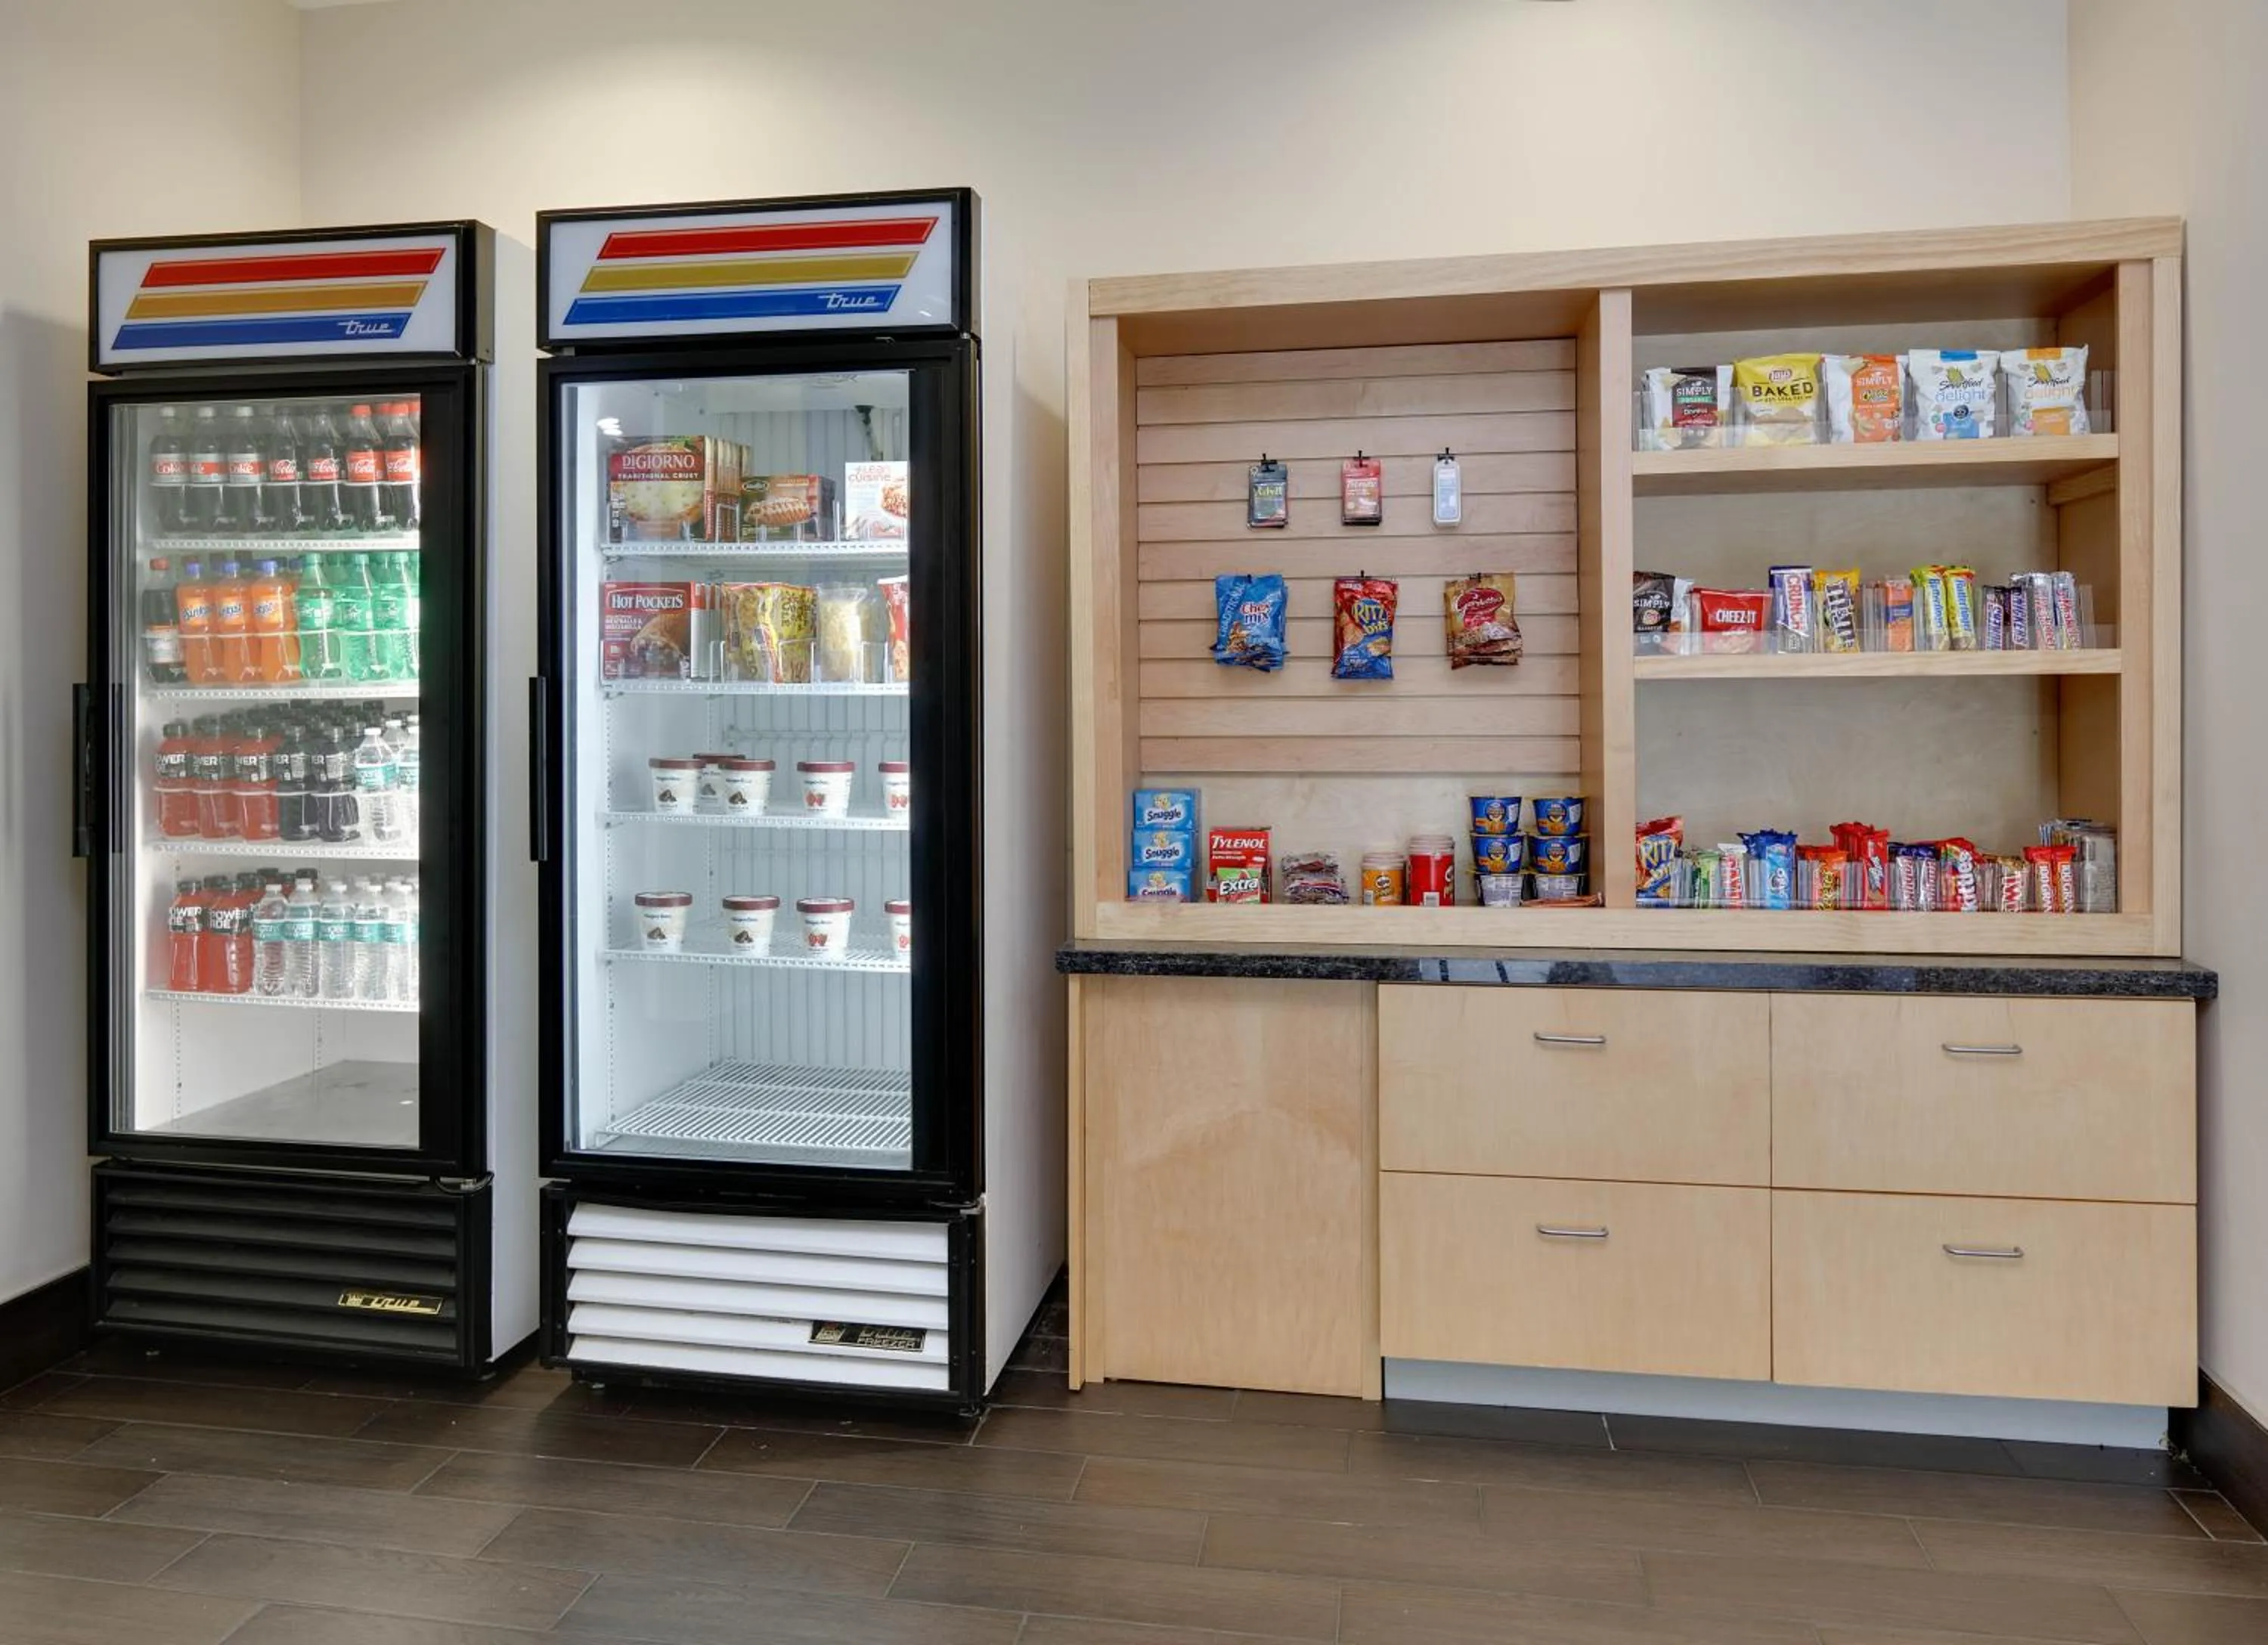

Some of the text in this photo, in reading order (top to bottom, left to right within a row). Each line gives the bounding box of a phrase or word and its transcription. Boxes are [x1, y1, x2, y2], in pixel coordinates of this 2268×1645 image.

[818, 293, 882, 309] true
[337, 320, 395, 336] true
[1676, 386, 1714, 397] SIMPLY
[1752, 381, 1814, 398] BAKED
[1935, 389, 1985, 404] delight
[611, 593, 684, 609] HOT POCKETS
[1147, 809, 1182, 822] Snuggle
[1211, 835, 1266, 849] TYLENOL
[1145, 846, 1180, 860] Snuggle
[1219, 878, 1259, 896] Extra
[2001, 870, 2022, 912] TWI
